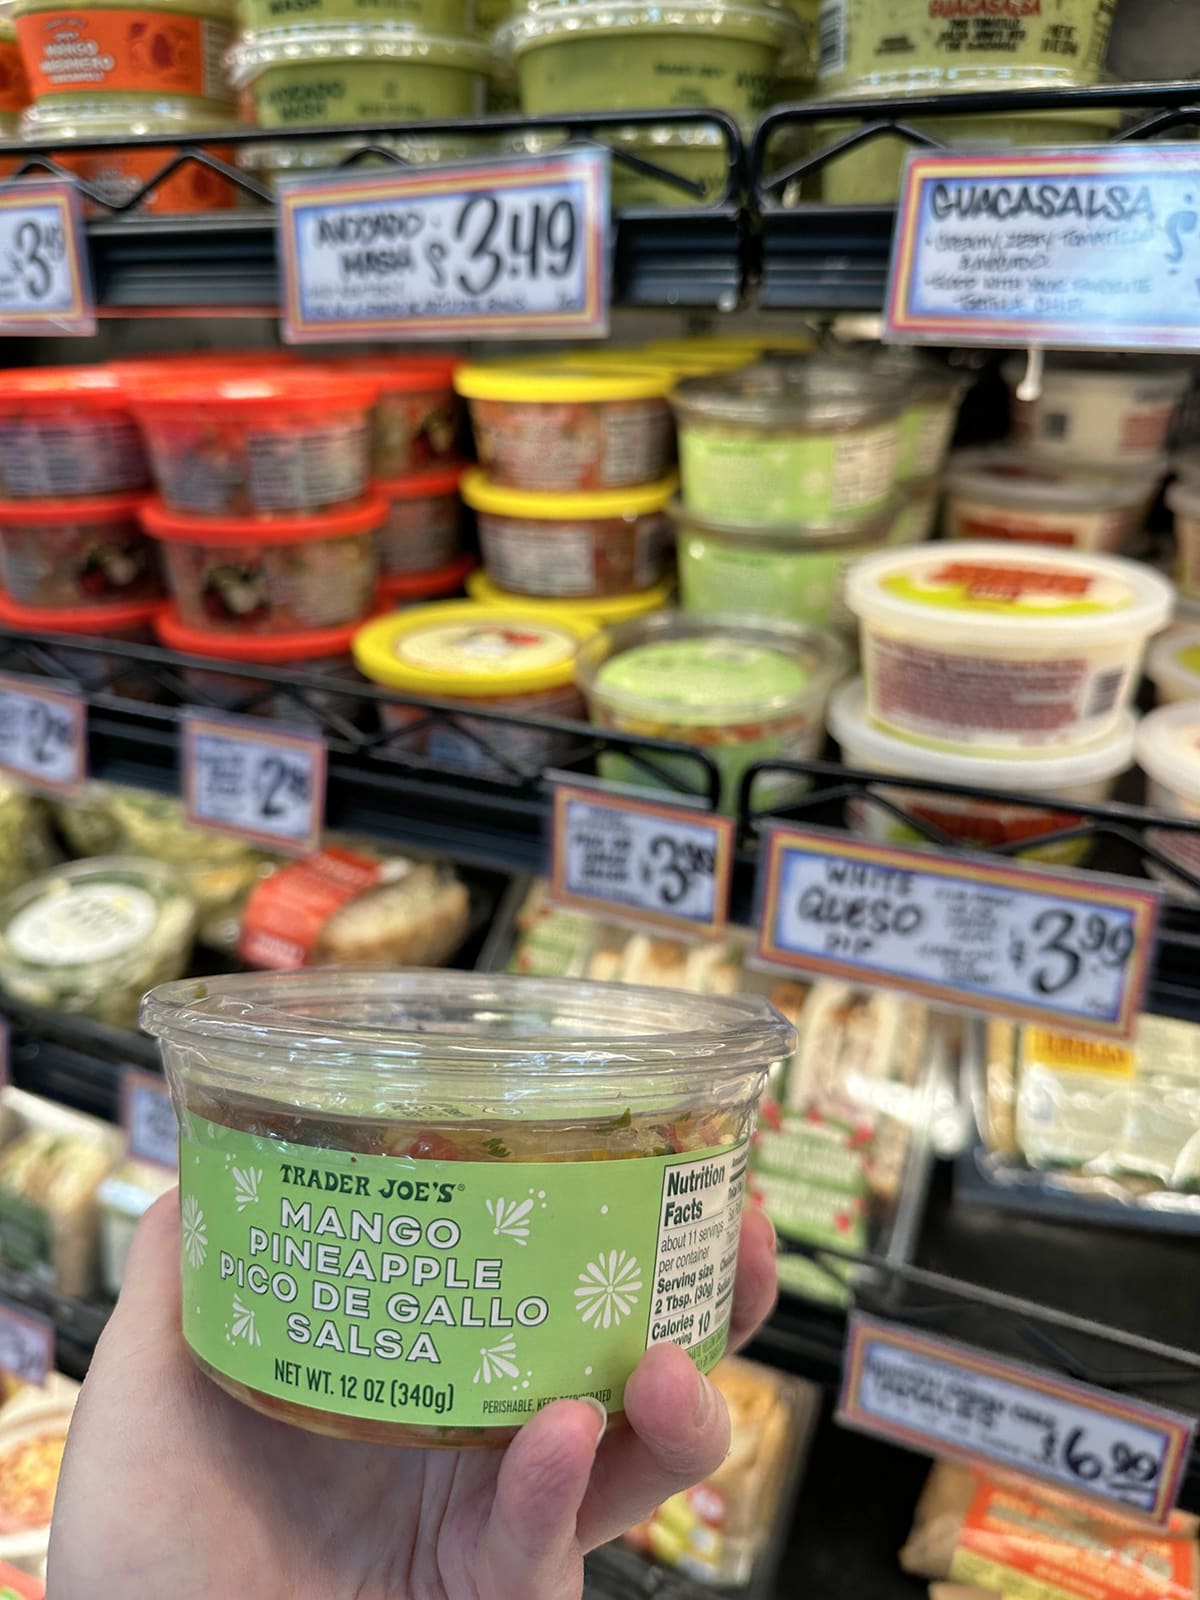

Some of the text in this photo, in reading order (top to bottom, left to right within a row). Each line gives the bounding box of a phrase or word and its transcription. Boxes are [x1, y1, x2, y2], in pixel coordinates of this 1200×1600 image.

[931, 183, 1156, 222] GUACASALSA
[823, 861, 917, 897] WHITE
[796, 884, 925, 936] QUESO
[279, 1163, 371, 1197] TRADER
[667, 1163, 725, 1197] Nutrition
[280, 1197, 461, 1250] MANGO
[664, 1198, 703, 1227] Facts
[660, 1231, 687, 1253] about
[688, 1228, 698, 1246] 11
[698, 1220, 725, 1242] servings
[249, 1225, 503, 1290] PINEAPPLE
[658, 1258, 674, 1277] per
[675, 1246, 710, 1269] container
[220, 1250, 549, 1328] PICO DE GALLO
[654, 1298, 663, 1315] 2
[666, 1293, 692, 1311] Tbsp.
[694, 1277, 714, 1304] (30g)
[657, 1271, 697, 1294] Serving
[698, 1263, 714, 1280] size
[286, 1312, 442, 1364] SALSA
[651, 1309, 711, 1341] Calories 10
[274, 1357, 454, 1414] NET WT. 12 OZ (340g)
